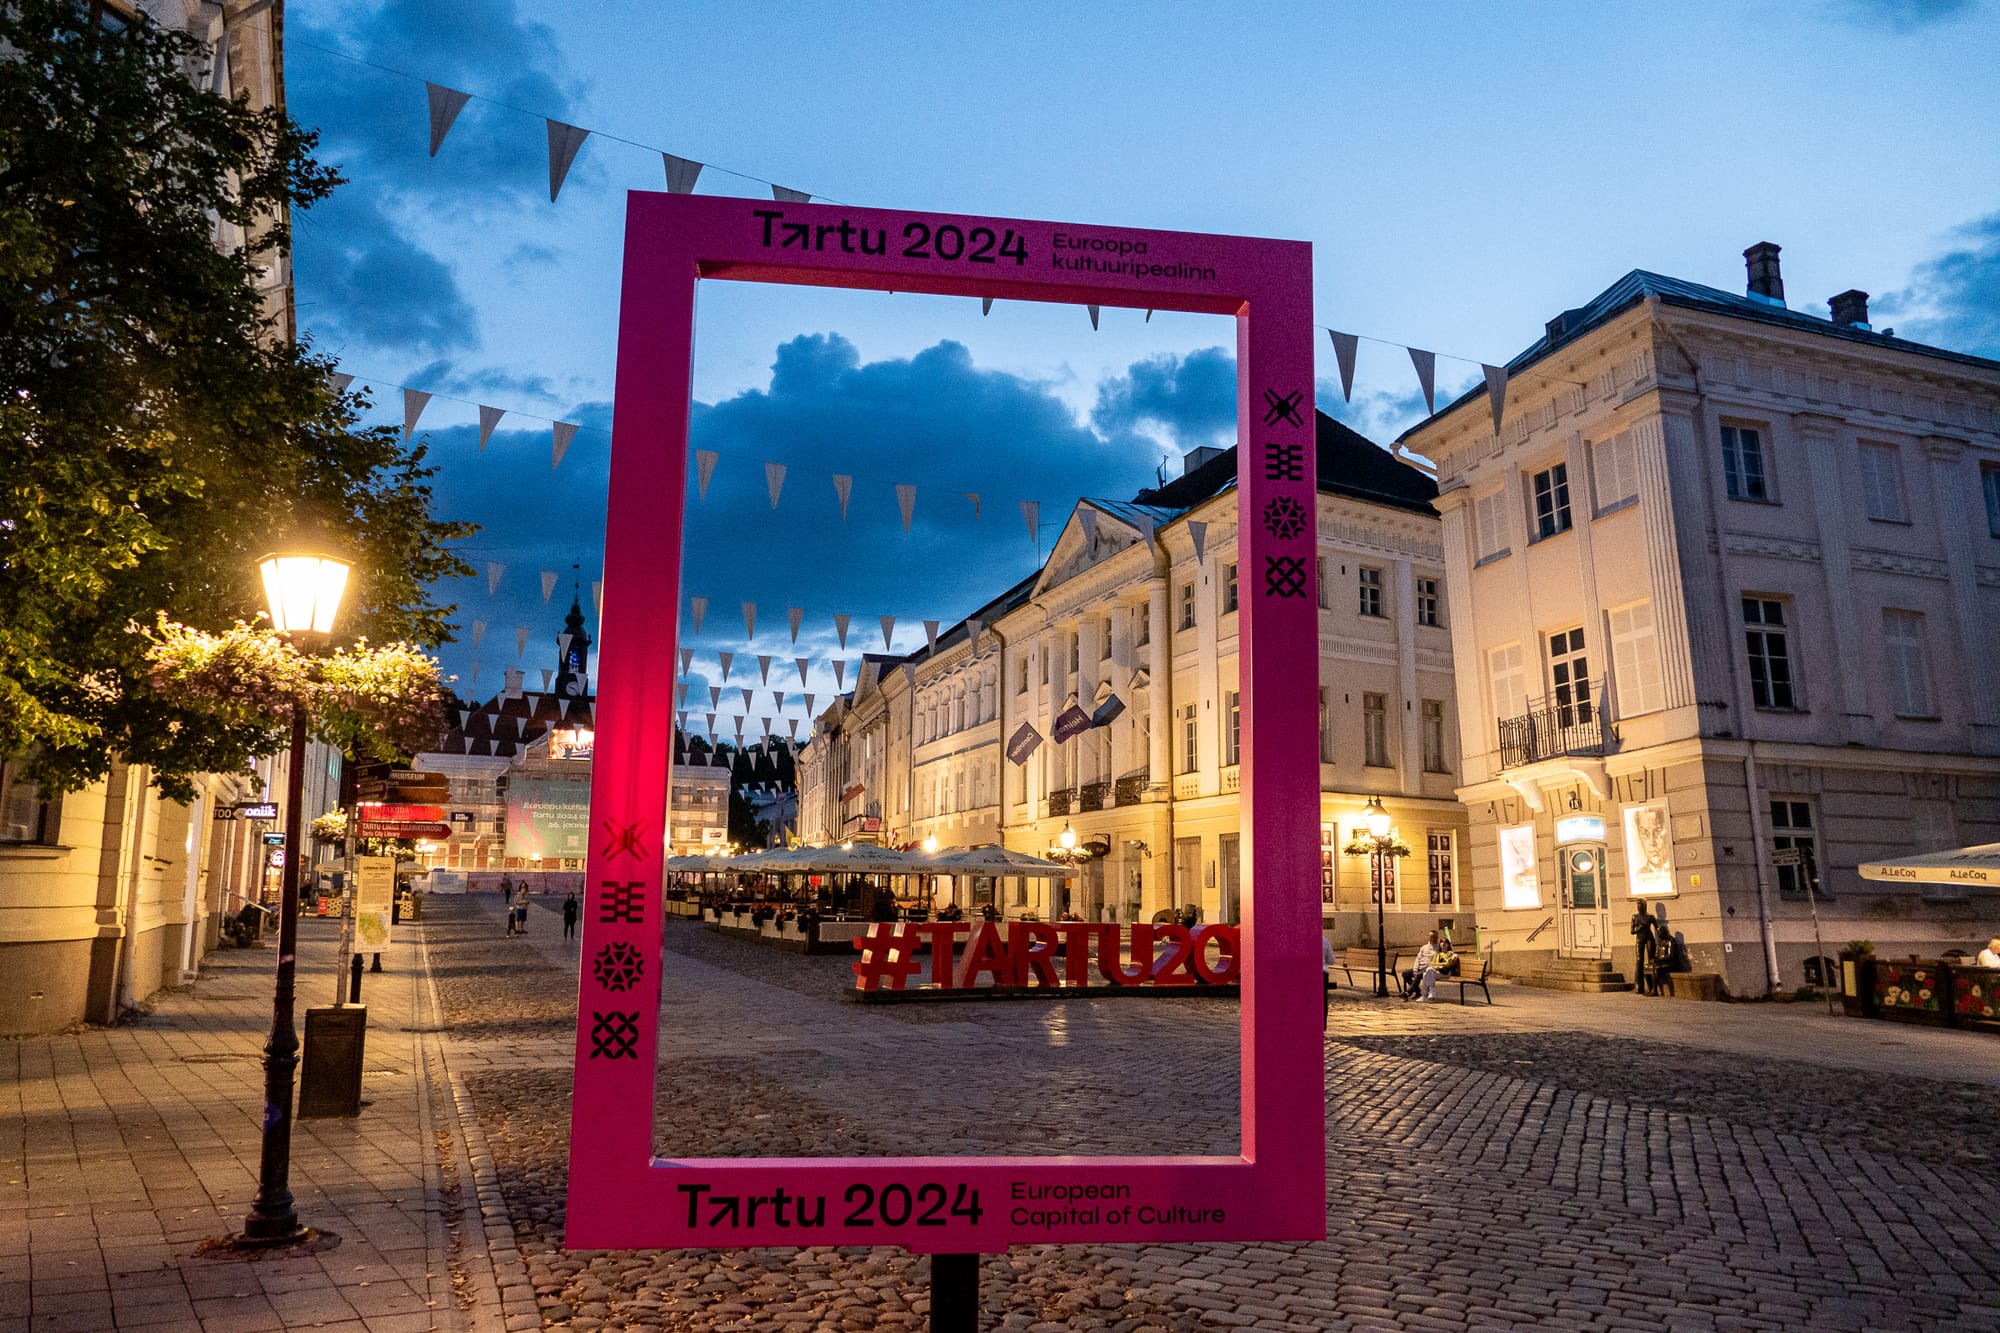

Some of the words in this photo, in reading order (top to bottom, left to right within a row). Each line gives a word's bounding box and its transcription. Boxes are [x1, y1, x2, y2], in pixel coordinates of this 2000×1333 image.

[753, 209, 886, 256] Tartu
[902, 222, 1029, 266] 2024
[1053, 233, 1147, 257] Euroopa
[1052, 253, 1216, 280] kultuuripealinn
[1570, 799, 1579, 809] 18
[362, 823, 381, 831] TARTU
[852, 921, 1241, 991] #TARTU20
[1011, 1181, 1131, 1204] European
[677, 1184, 826, 1228] Tartu
[843, 1183, 984, 1227] 2024
[1010, 1206, 1100, 1230] Capital
[1106, 1205, 1132, 1225] of
[1137, 1205, 1226, 1226] Culture
